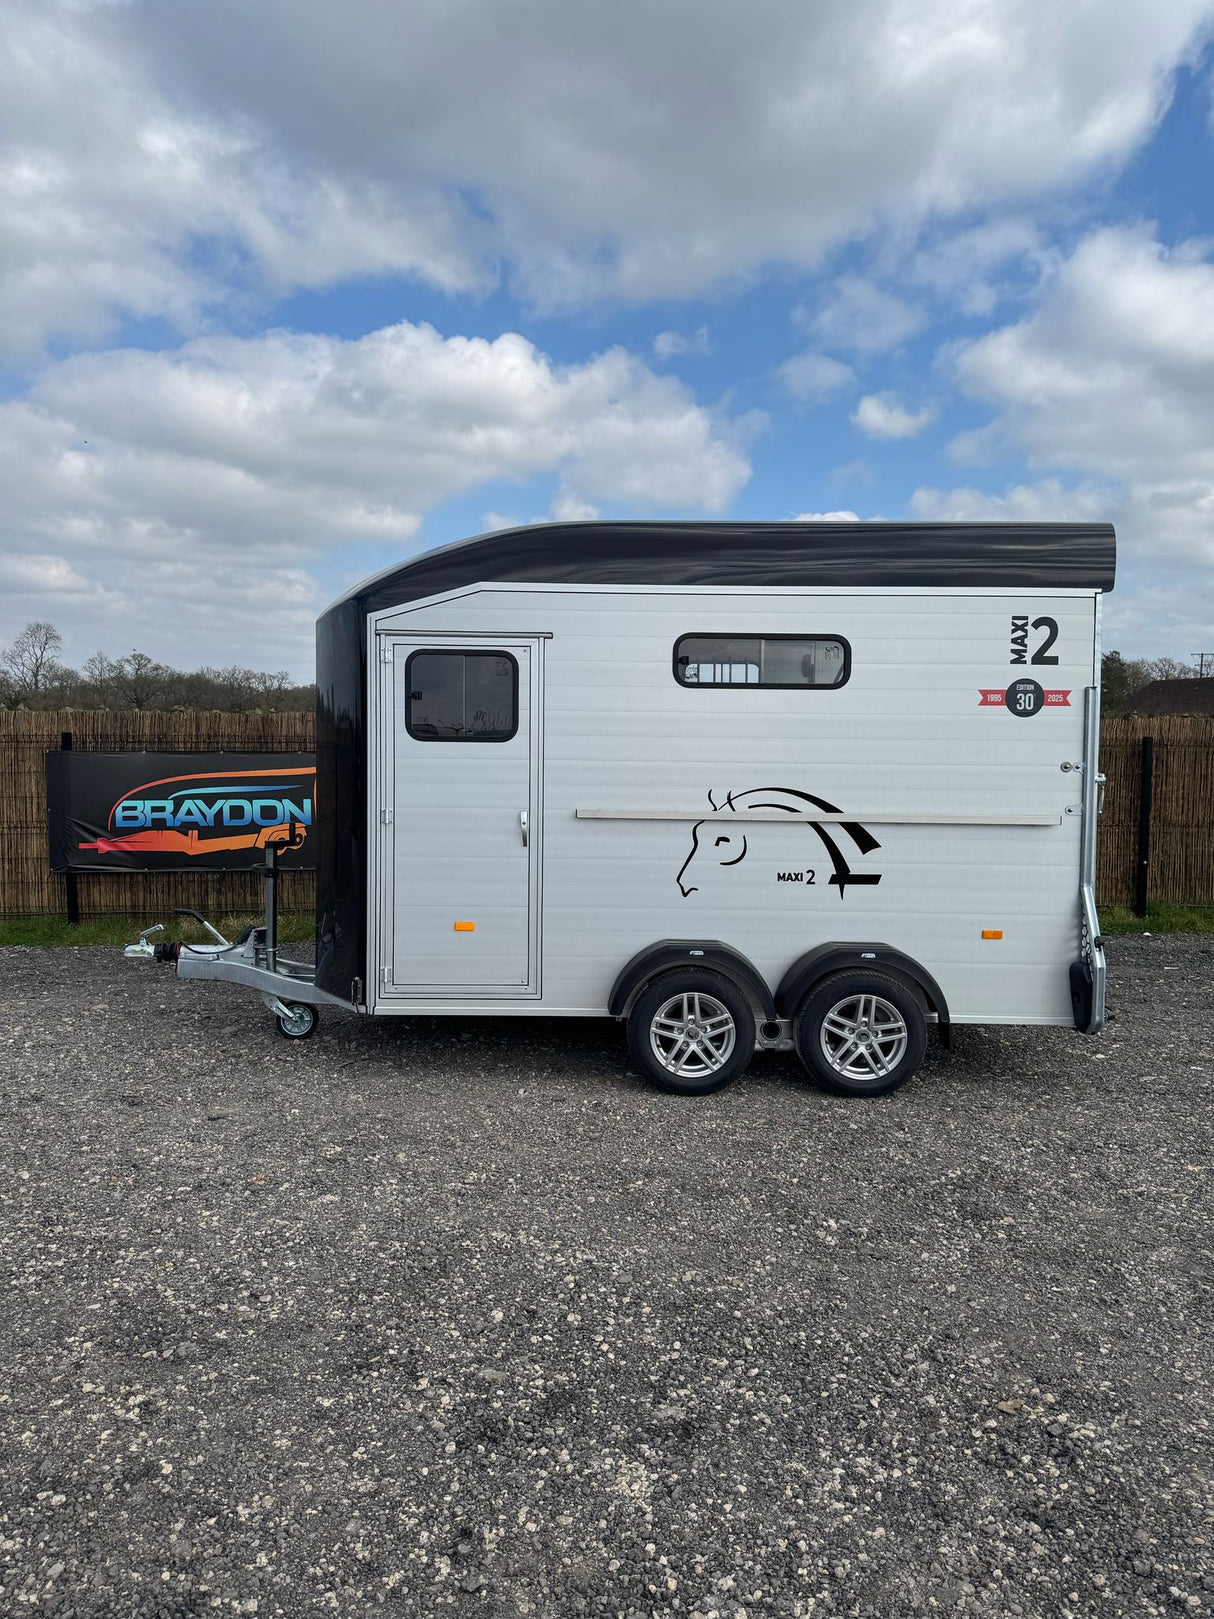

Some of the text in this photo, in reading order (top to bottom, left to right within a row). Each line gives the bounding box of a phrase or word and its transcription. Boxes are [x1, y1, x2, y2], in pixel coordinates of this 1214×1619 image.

[1010, 615, 1059, 665] MAXI 2
[986, 694, 1002, 702] 1995
[1016, 693, 1034, 710] 30
[1047, 694, 1064, 702] 2025
[115, 798, 312, 828] BRAYDON
[777, 869, 816, 885] MAXI 2
